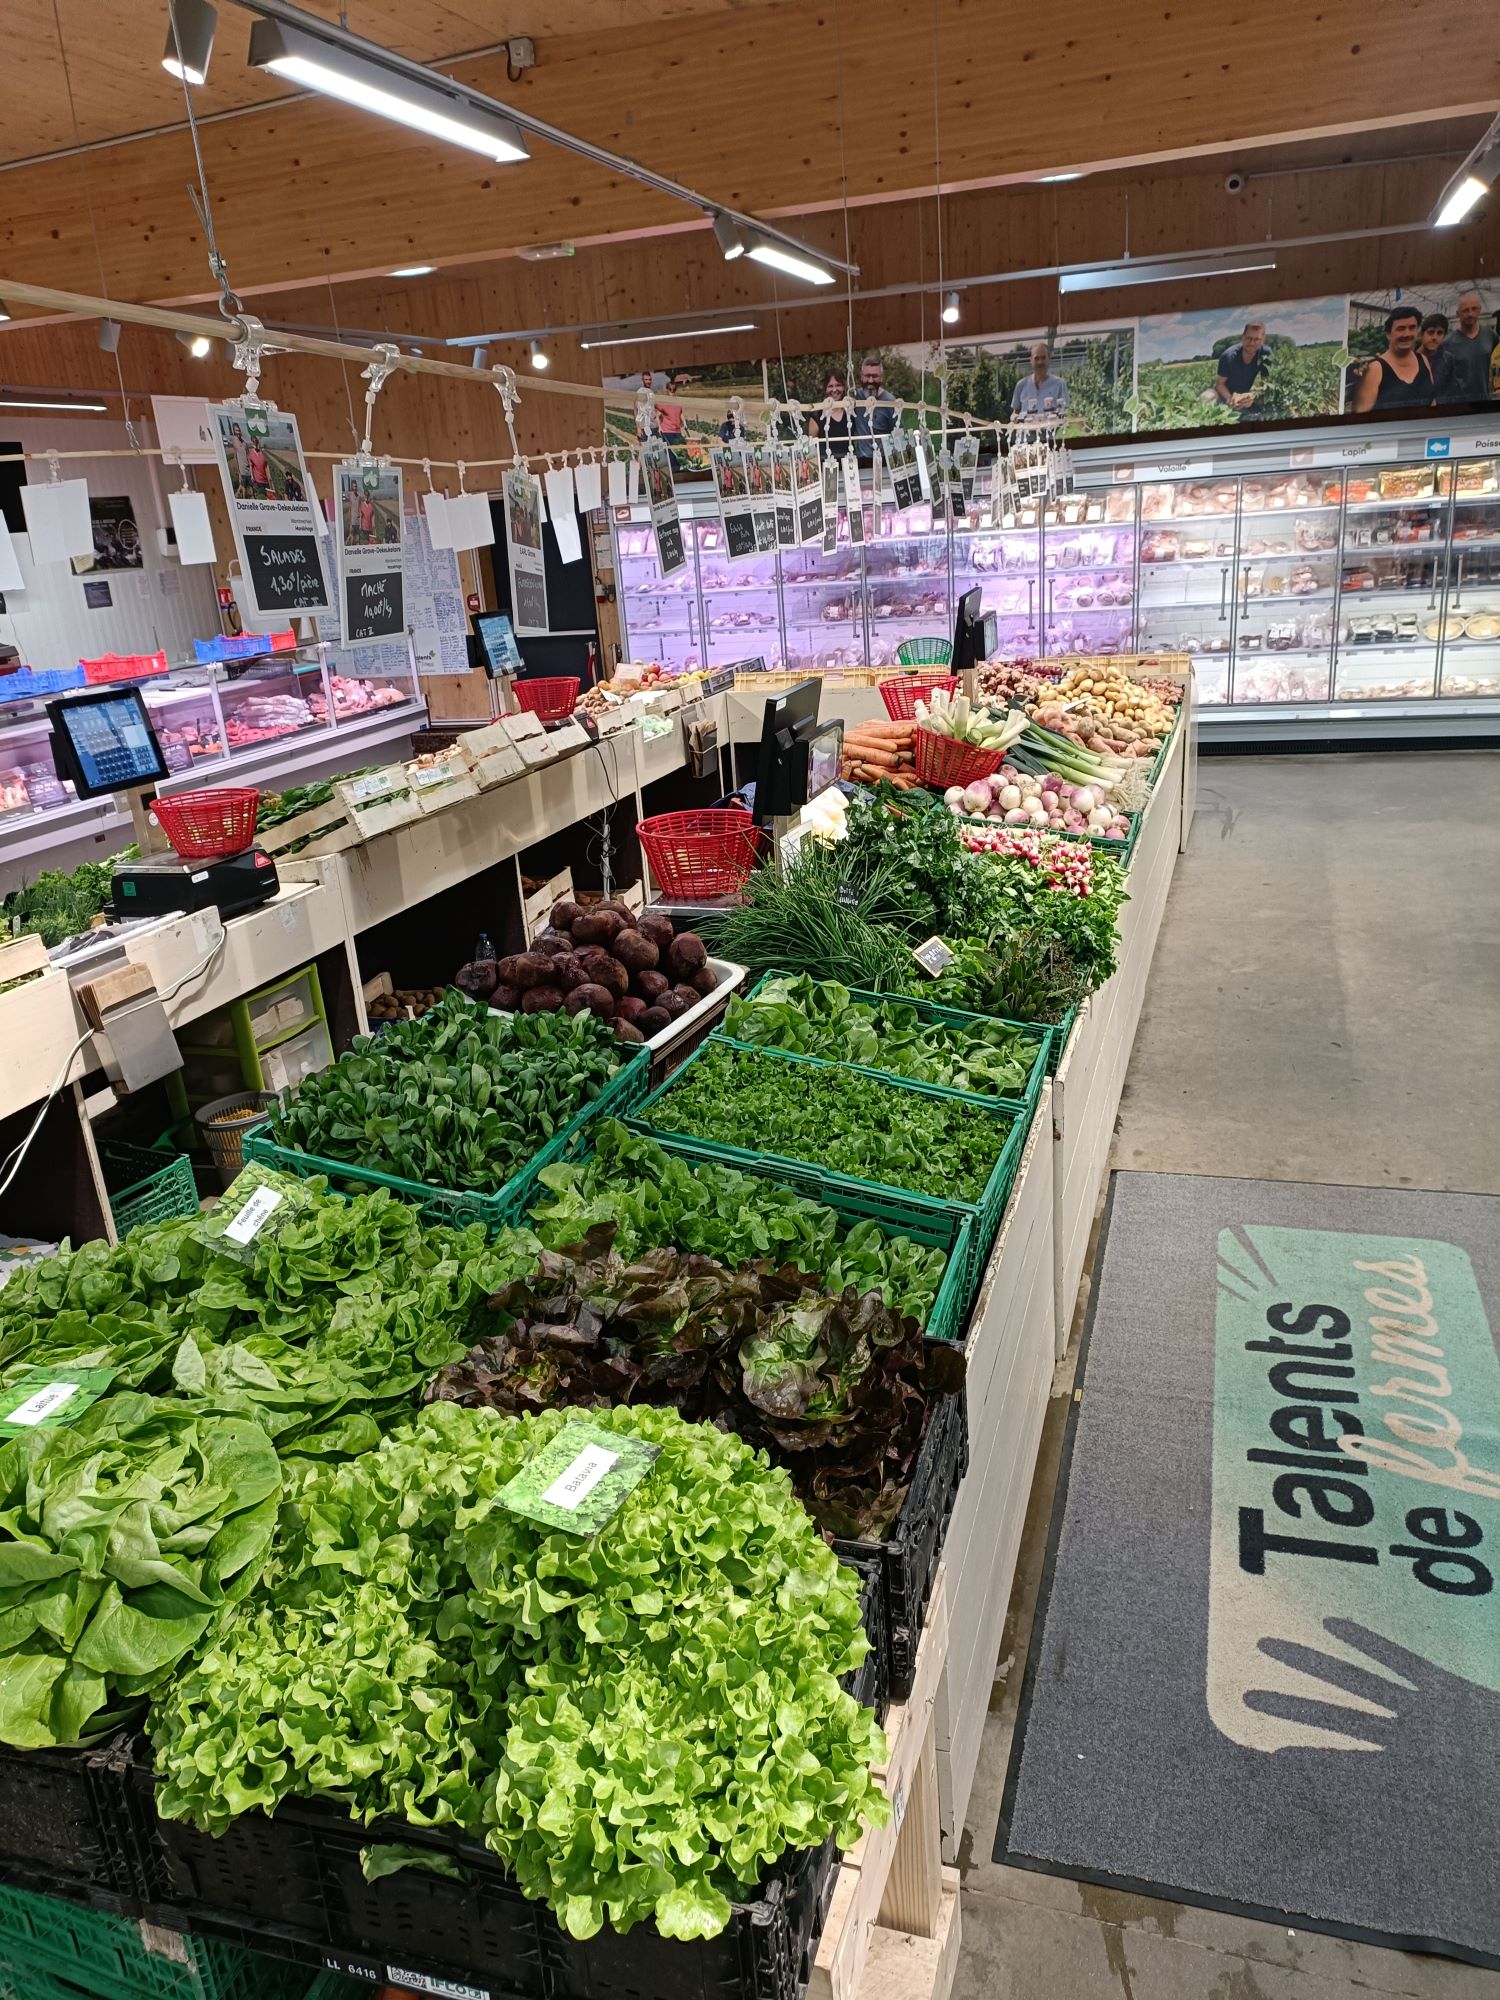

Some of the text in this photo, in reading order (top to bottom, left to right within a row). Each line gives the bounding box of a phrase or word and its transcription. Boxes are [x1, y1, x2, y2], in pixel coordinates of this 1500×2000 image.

[1475, 440, 1500, 448] Poiss
[1342, 447, 1367, 457] Lapin
[1157, 463, 1187, 473] Volaille
[236, 501, 259, 511] Danielle
[260, 545, 306, 566] SALADES
[344, 546, 362, 556] Danielle
[293, 597, 309, 608] CAT
[356, 629, 367, 638] CAT
[237, 1199, 262, 1227] Feuille de
[253, 1209, 269, 1227] chêne
[1238, 1302, 1380, 1576] Talents
[565, 1461, 598, 1492] Batavia
[1389, 1505, 1495, 1598] de
[327, 1958, 376, 1980] LL 6416
